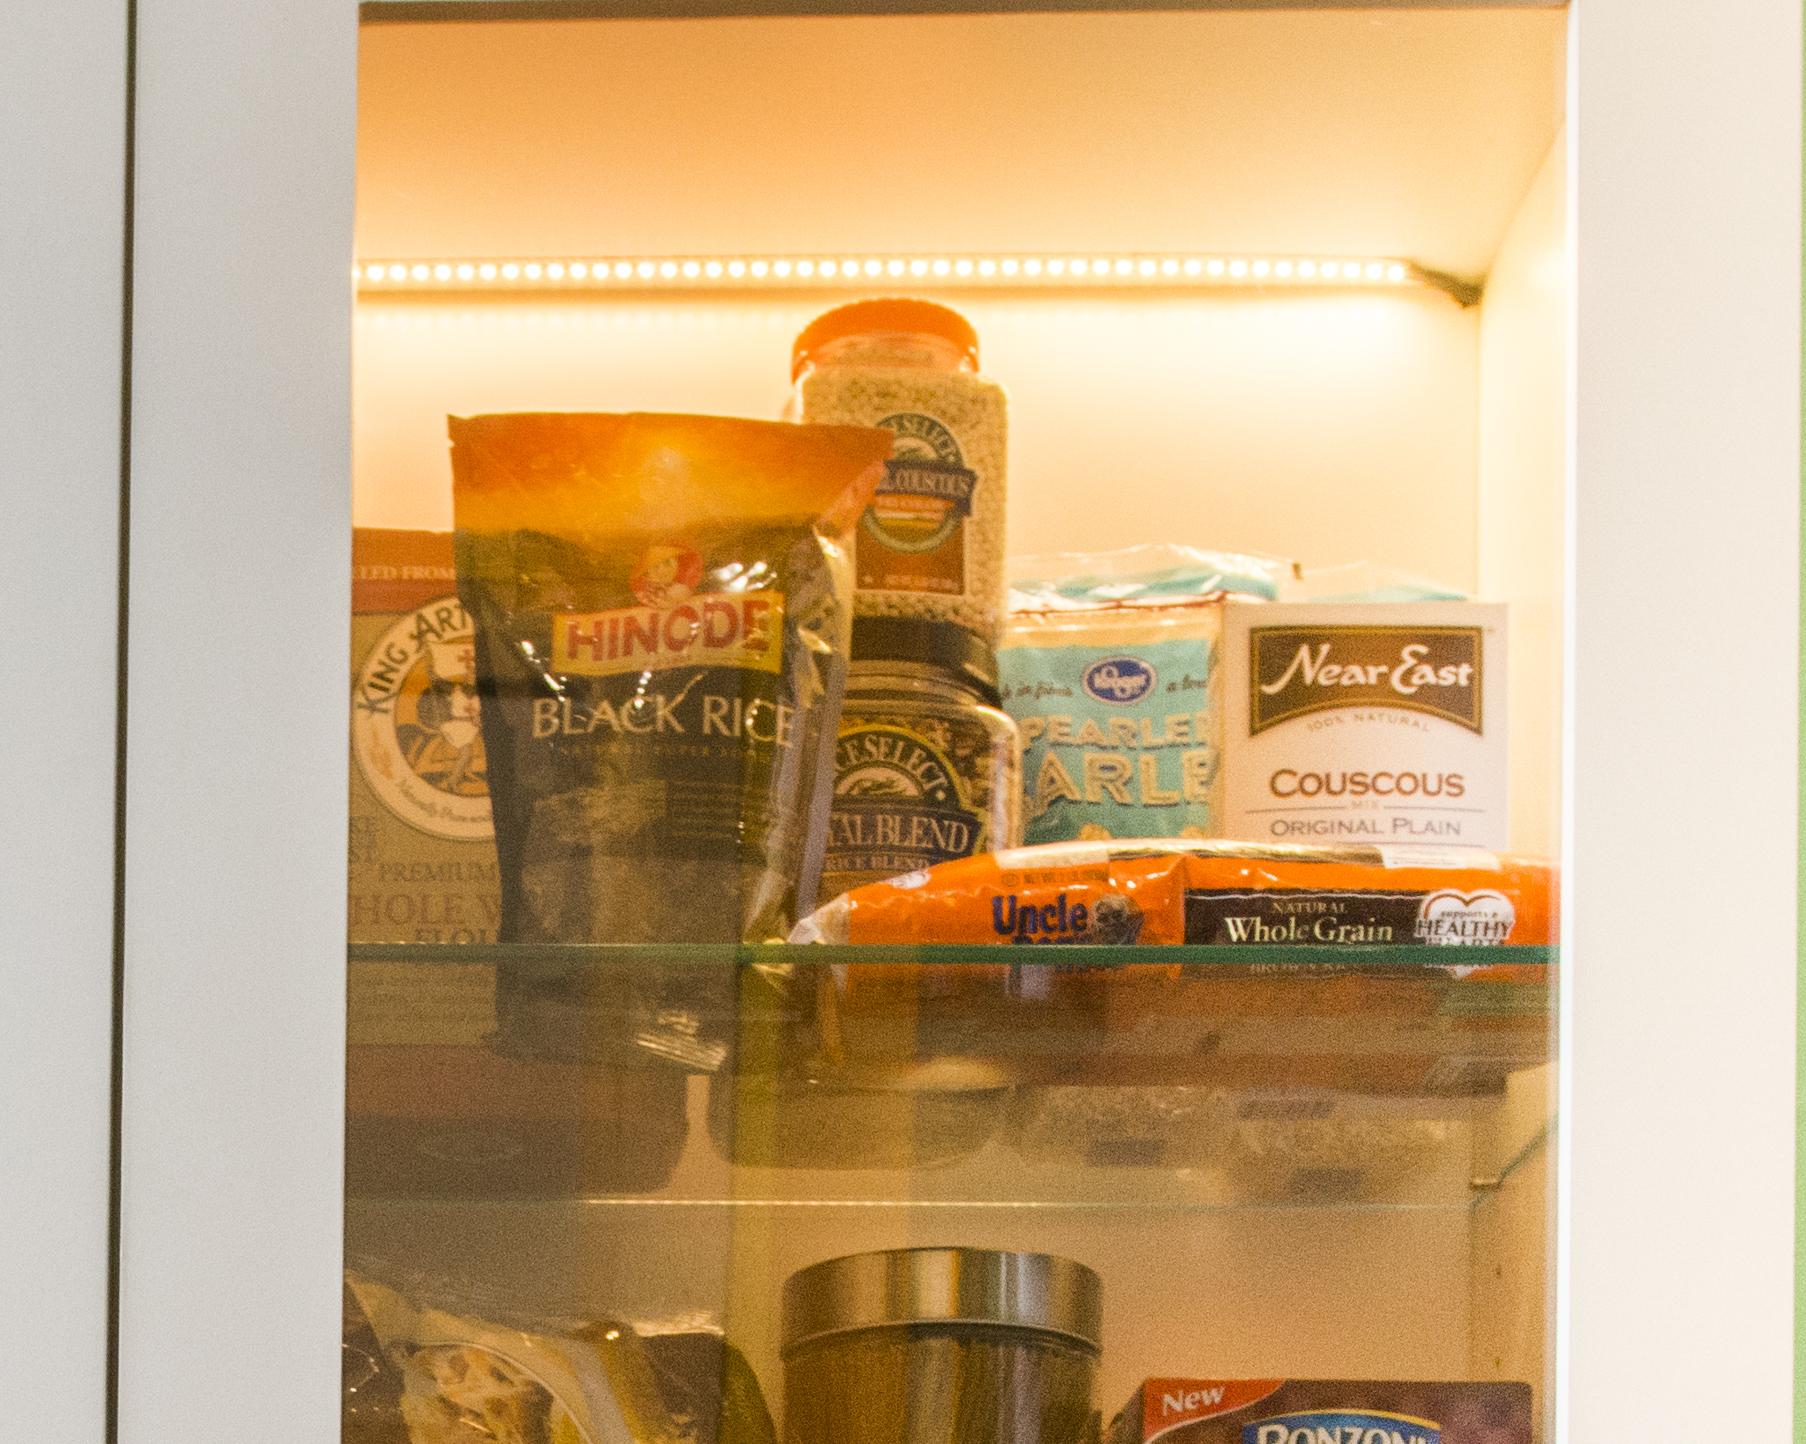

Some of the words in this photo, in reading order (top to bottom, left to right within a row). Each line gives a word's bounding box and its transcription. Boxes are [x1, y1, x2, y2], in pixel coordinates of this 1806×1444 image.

[566, 600, 771, 662] HINODE
[356, 641, 408, 718] KING
[1260, 642, 1389, 696] Near
[1390, 643, 1474, 696] East
[531, 680, 691, 740] BLACK
[702, 695, 796, 748] RICE
[1352, 711, 1431, 733] NATURAL
[1269, 768, 1467, 799] COUSCOUS
[875, 813, 971, 854] BLEND
[1269, 818, 1386, 837] ORIGINAL
[1391, 816, 1462, 837] PLAIN
[990, 892, 1088, 935] Uncle
[1271, 900, 1347, 915] NATURAL
[1224, 914, 1310, 945] Whole
[1312, 917, 1394, 946] Grain
[1417, 918, 1512, 940] HEALTHY
[1160, 1385, 1226, 1416] New
